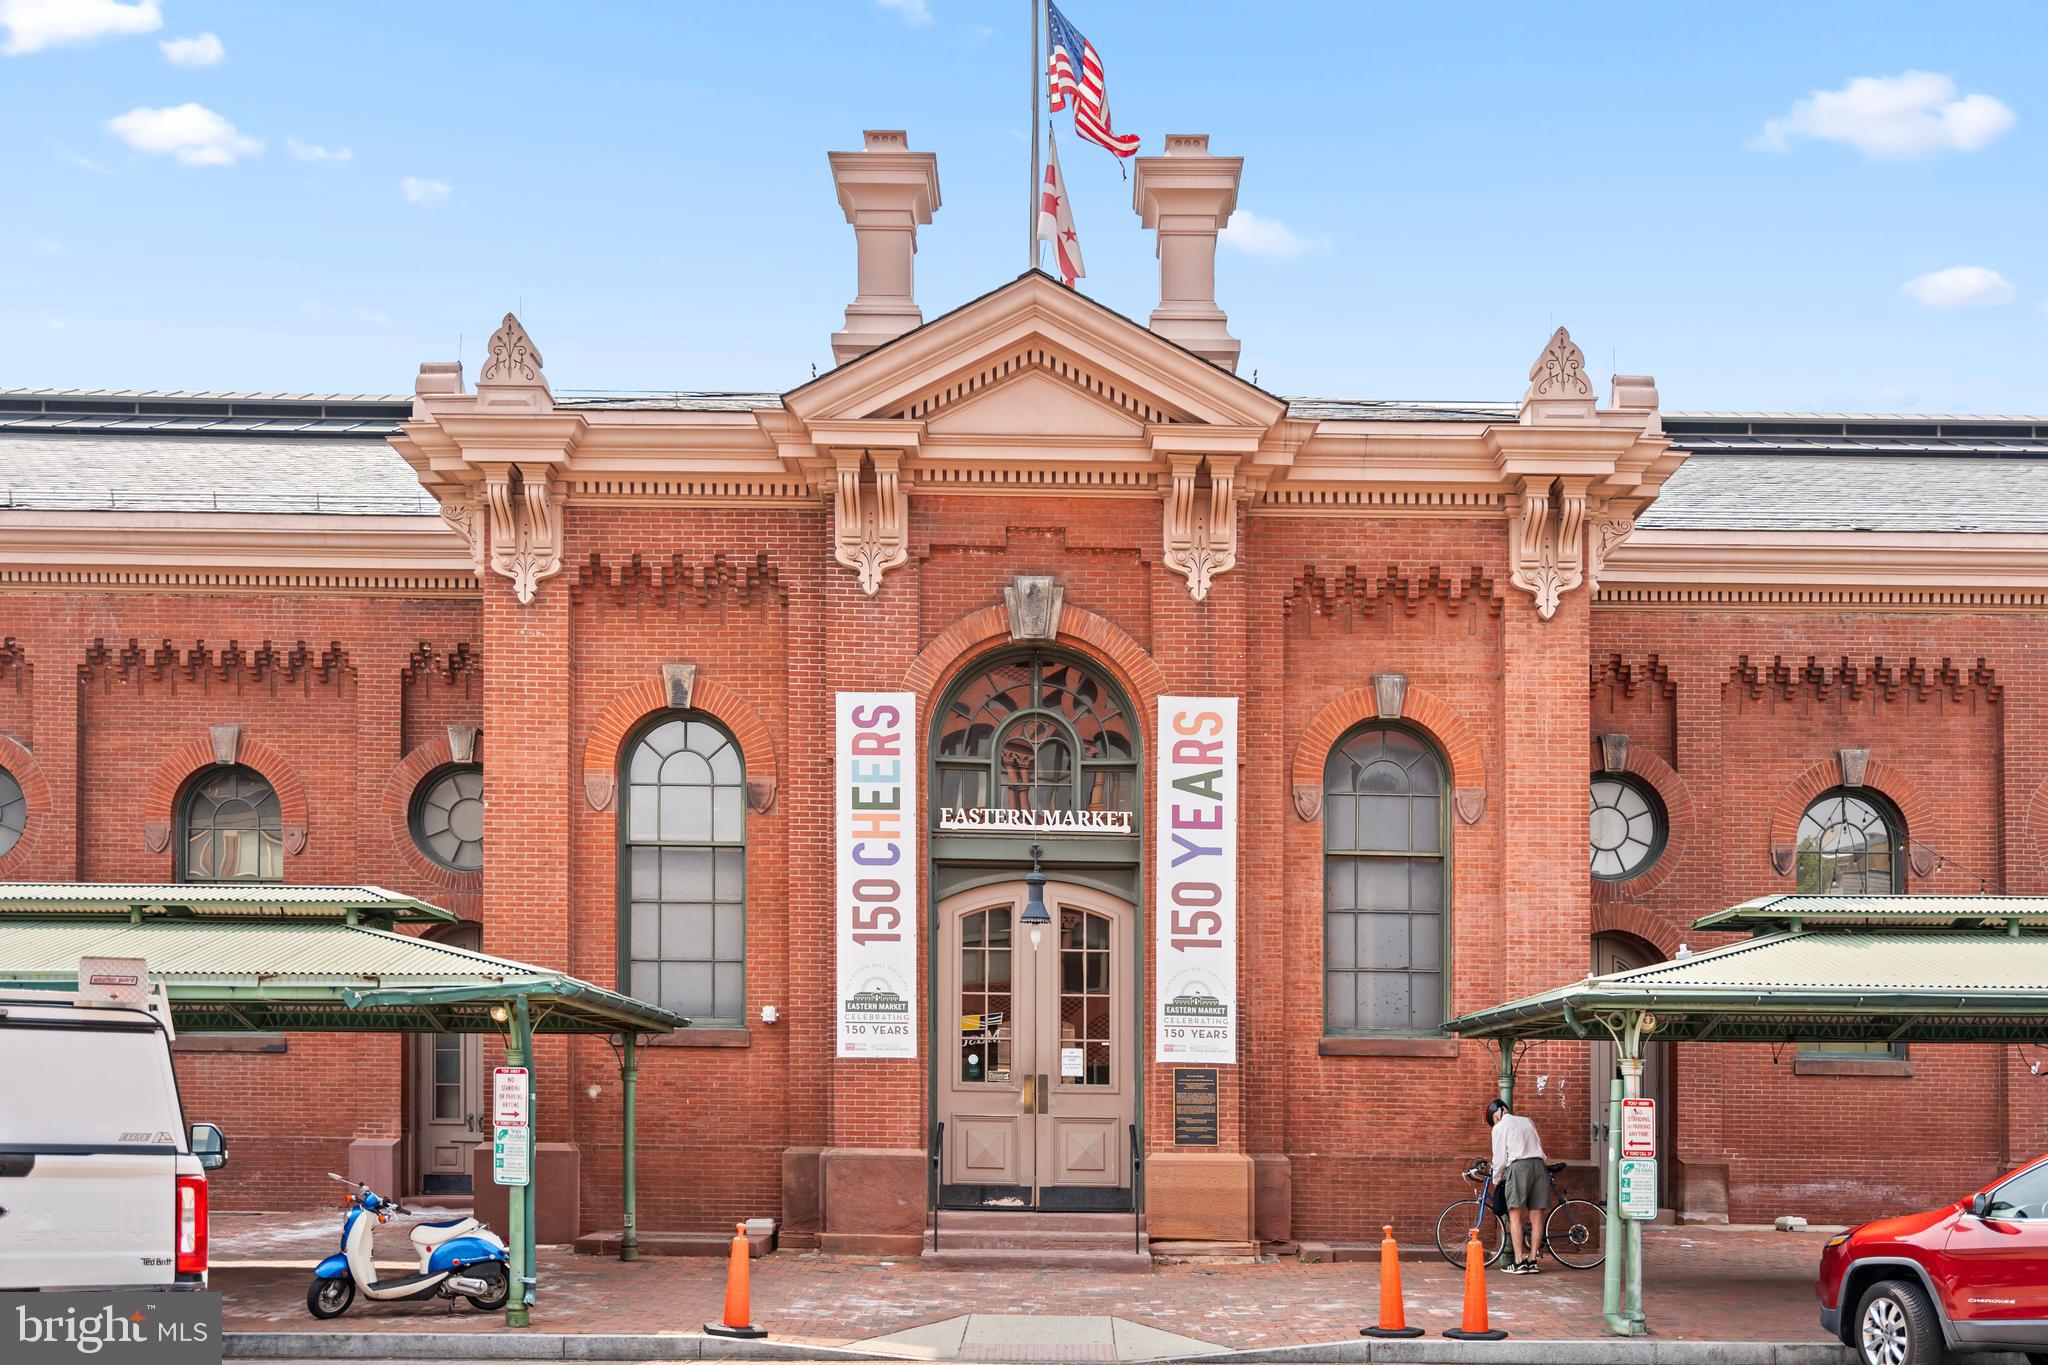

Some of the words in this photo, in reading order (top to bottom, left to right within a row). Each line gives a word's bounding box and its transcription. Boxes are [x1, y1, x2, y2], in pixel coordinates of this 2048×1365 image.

[851, 705, 901, 866] CHEERS
[1171, 711, 1224, 869] YEARS
[940, 807, 1037, 826] EASTERN
[1042, 809, 1132, 828] MARKET
[851, 878, 902, 947] 150
[1170, 881, 1223, 953] 150
[844, 1013, 910, 1021] CELEBRATING
[1163, 1017, 1229, 1025] CELEBRATING
[845, 1025, 866, 1034] 150
[872, 1026, 909, 1035] YEARS
[1164, 1029, 1185, 1038] 150
[1191, 1029, 1228, 1039] YEARS
[140, 1257, 155, 1266] Ted
